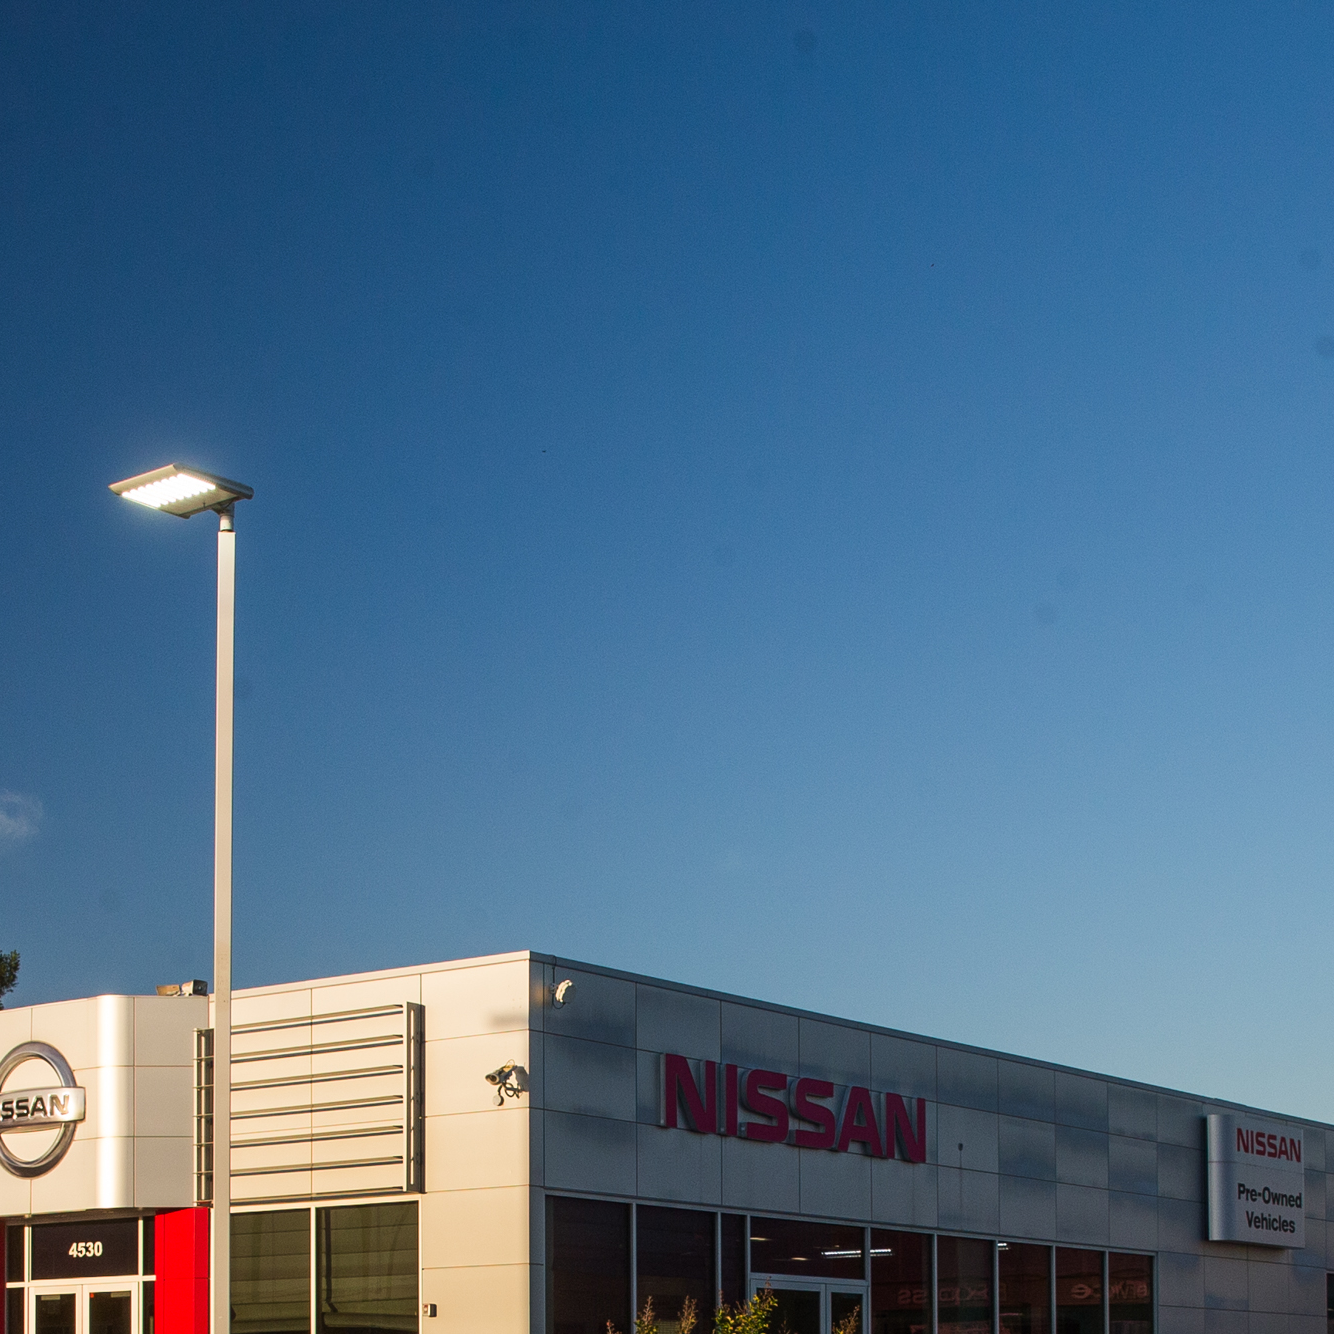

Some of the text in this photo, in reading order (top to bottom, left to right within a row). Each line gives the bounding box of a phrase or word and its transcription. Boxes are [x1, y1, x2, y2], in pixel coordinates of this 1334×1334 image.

[664, 1052, 926, 1163] NISSAN
[1236, 1127, 1301, 1163] NISSAN
[1238, 1182, 1302, 1208] Pre-Owned
[1246, 1210, 1295, 1234] Vehicles
[68, 1241, 103, 1258] 4530
